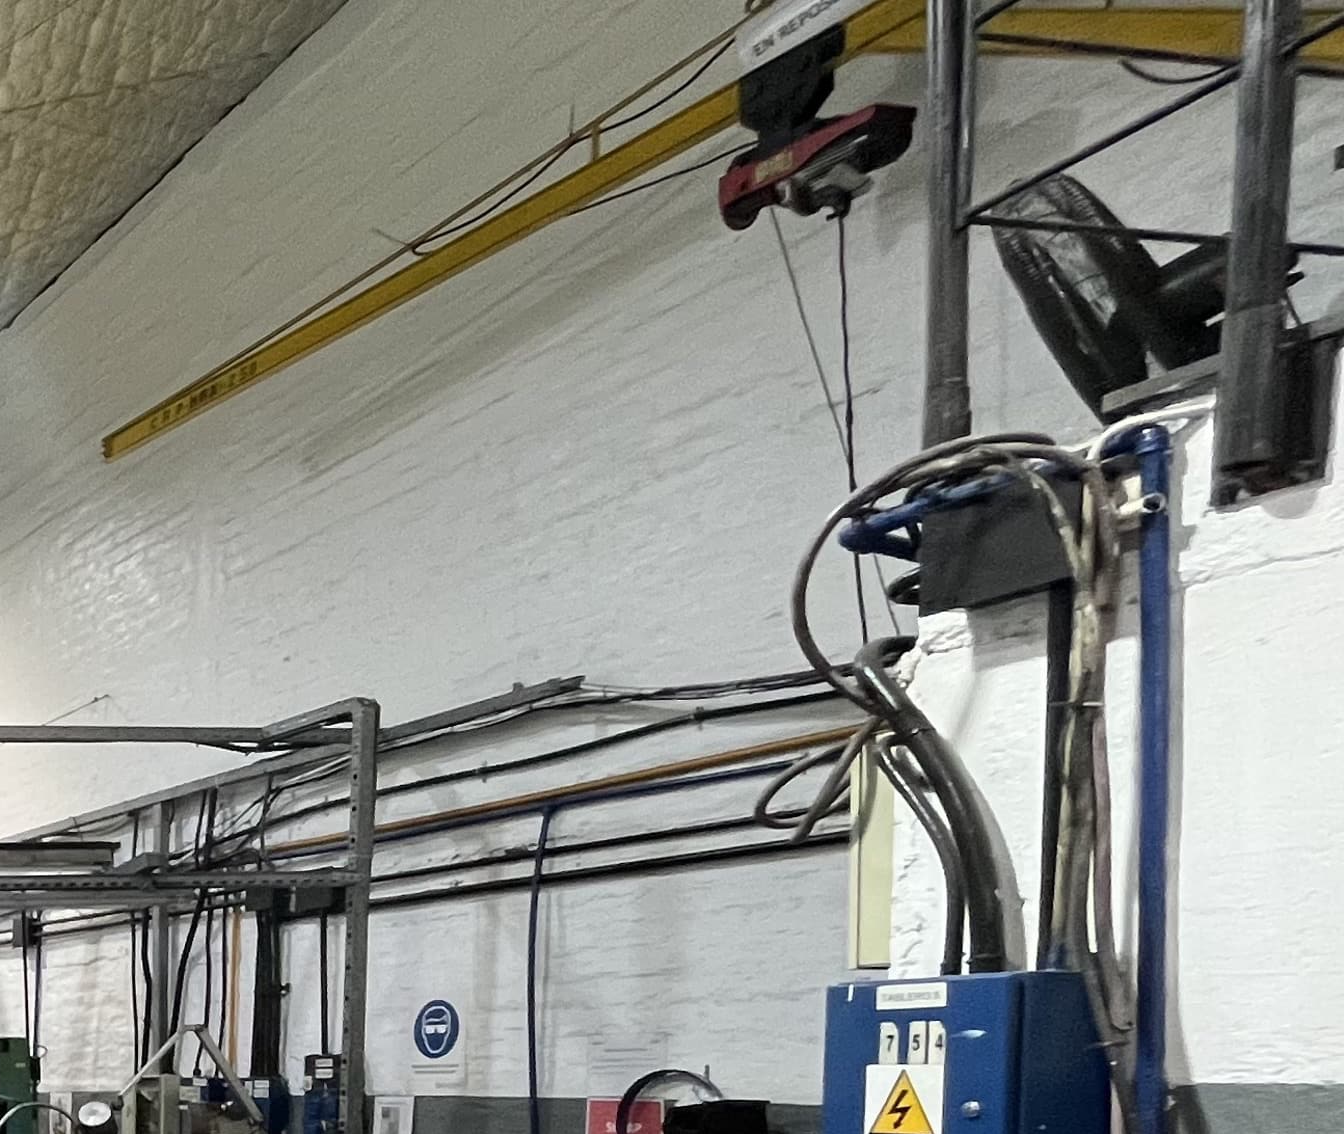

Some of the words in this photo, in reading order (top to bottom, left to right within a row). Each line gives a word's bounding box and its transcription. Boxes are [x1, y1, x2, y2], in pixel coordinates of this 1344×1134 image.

[886, 1034, 895, 1052] 7
[912, 1034, 921, 1051] 5
[935, 1033, 944, 1051] 4
